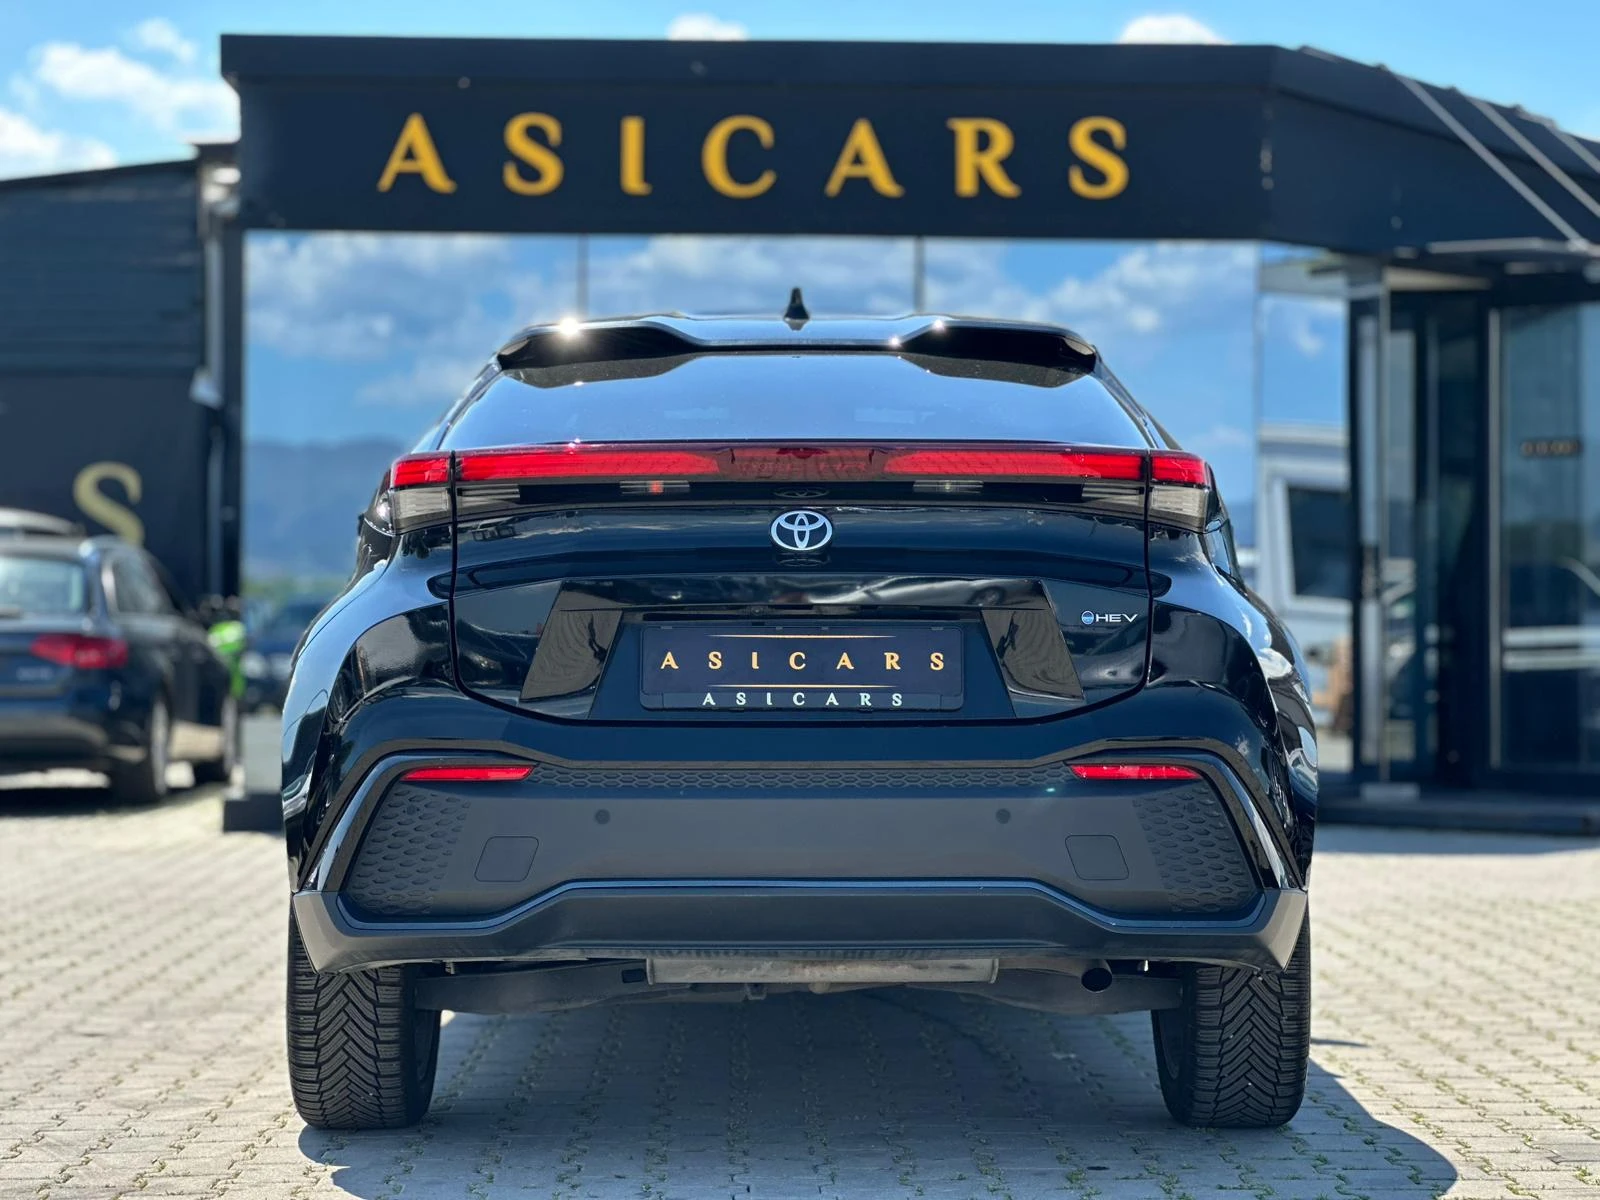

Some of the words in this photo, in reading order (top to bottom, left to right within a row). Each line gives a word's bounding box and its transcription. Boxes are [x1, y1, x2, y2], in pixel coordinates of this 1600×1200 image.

[376, 112, 1131, 200] ASICARS
[1095, 613, 1138, 623] HEV
[660, 651, 945, 671] ASICARS
[702, 692, 903, 707] ASICARS
